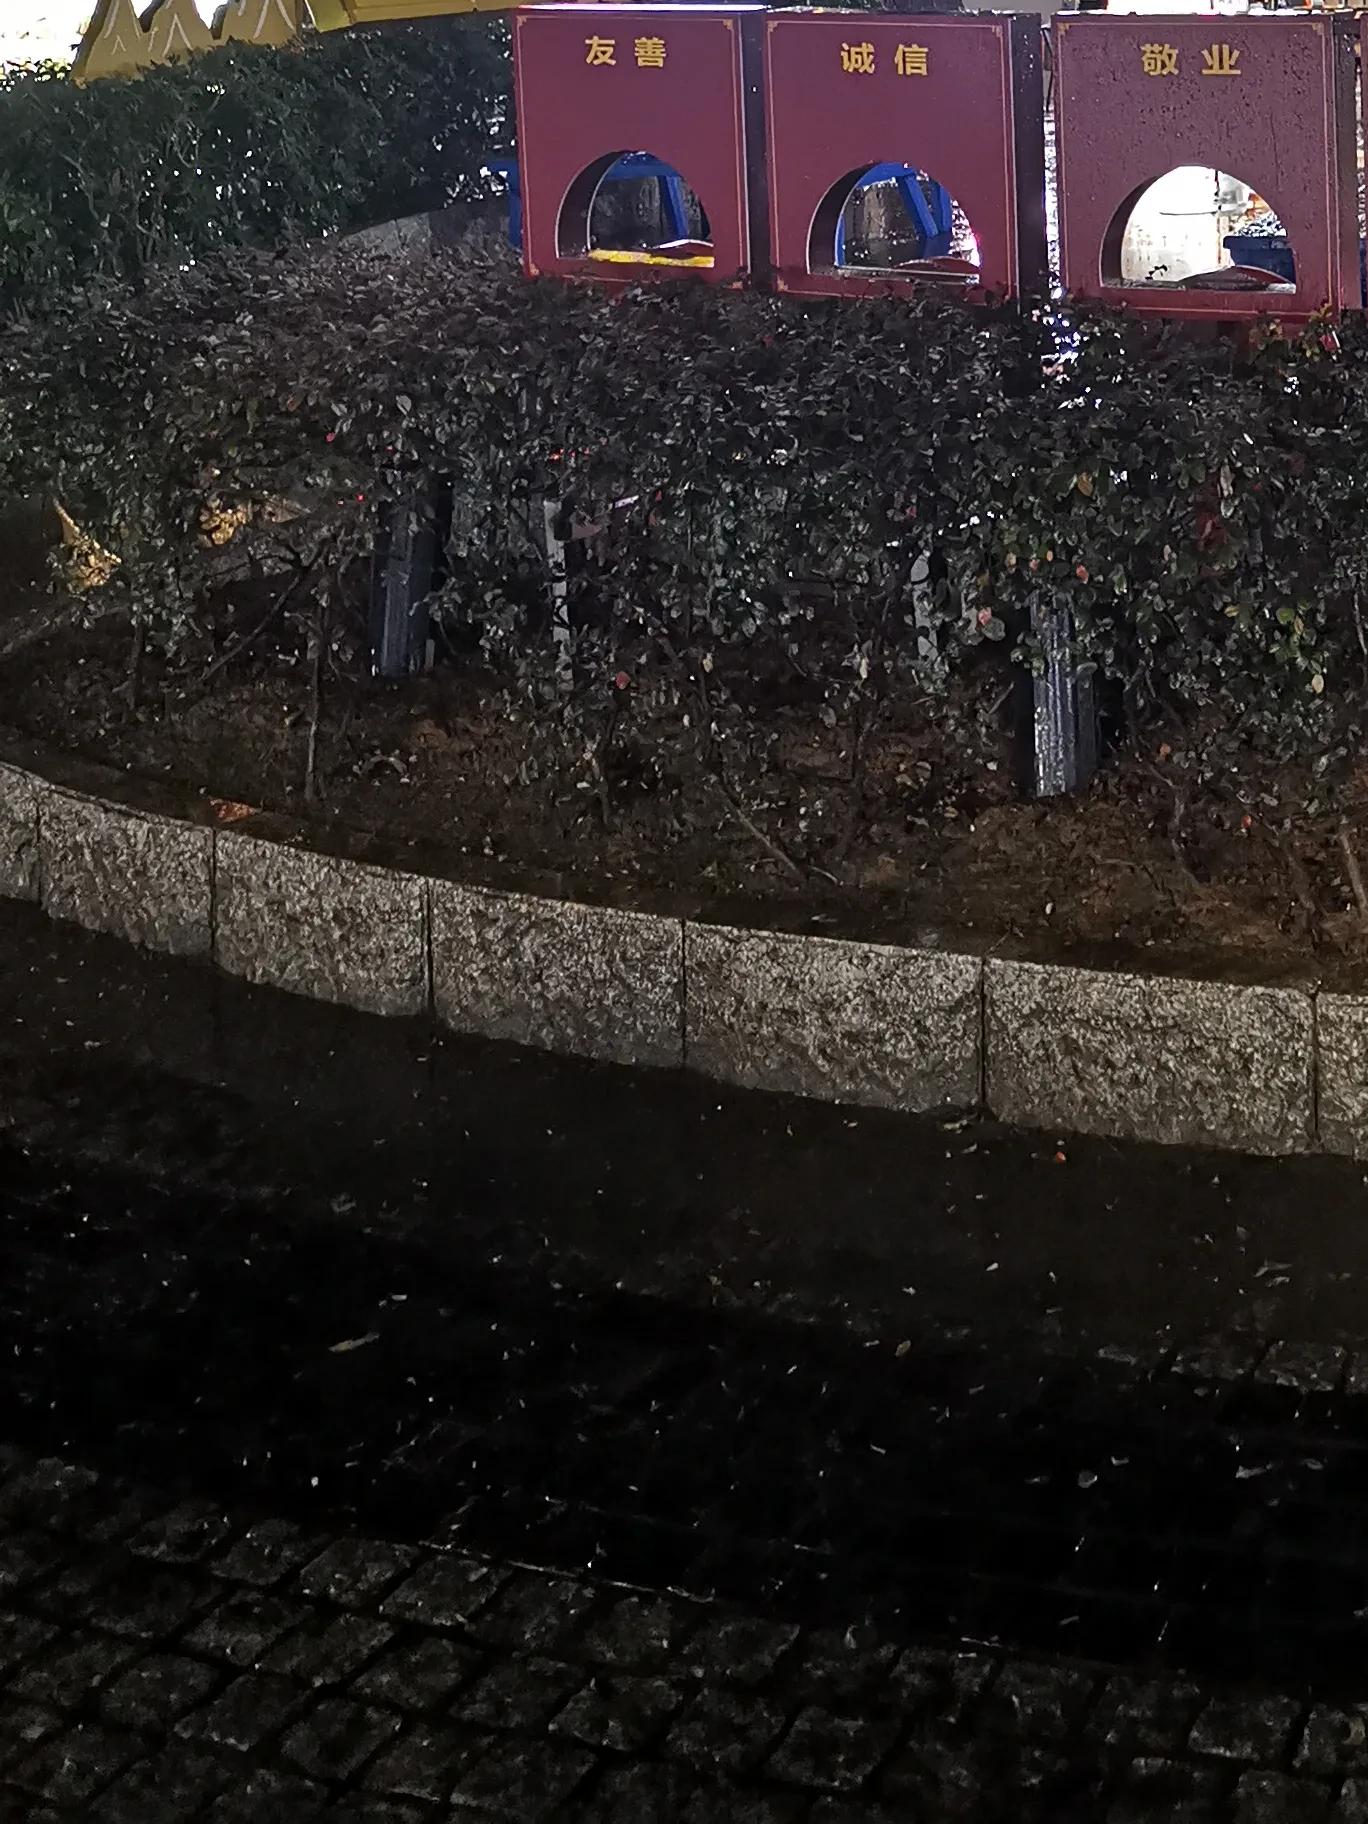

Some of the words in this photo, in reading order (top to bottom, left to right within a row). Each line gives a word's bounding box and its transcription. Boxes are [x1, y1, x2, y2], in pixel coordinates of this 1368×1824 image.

[584, 35, 668, 69] 友善
[840, 42, 930, 76] 诚信
[1140, 43, 1242, 77] 敬业
